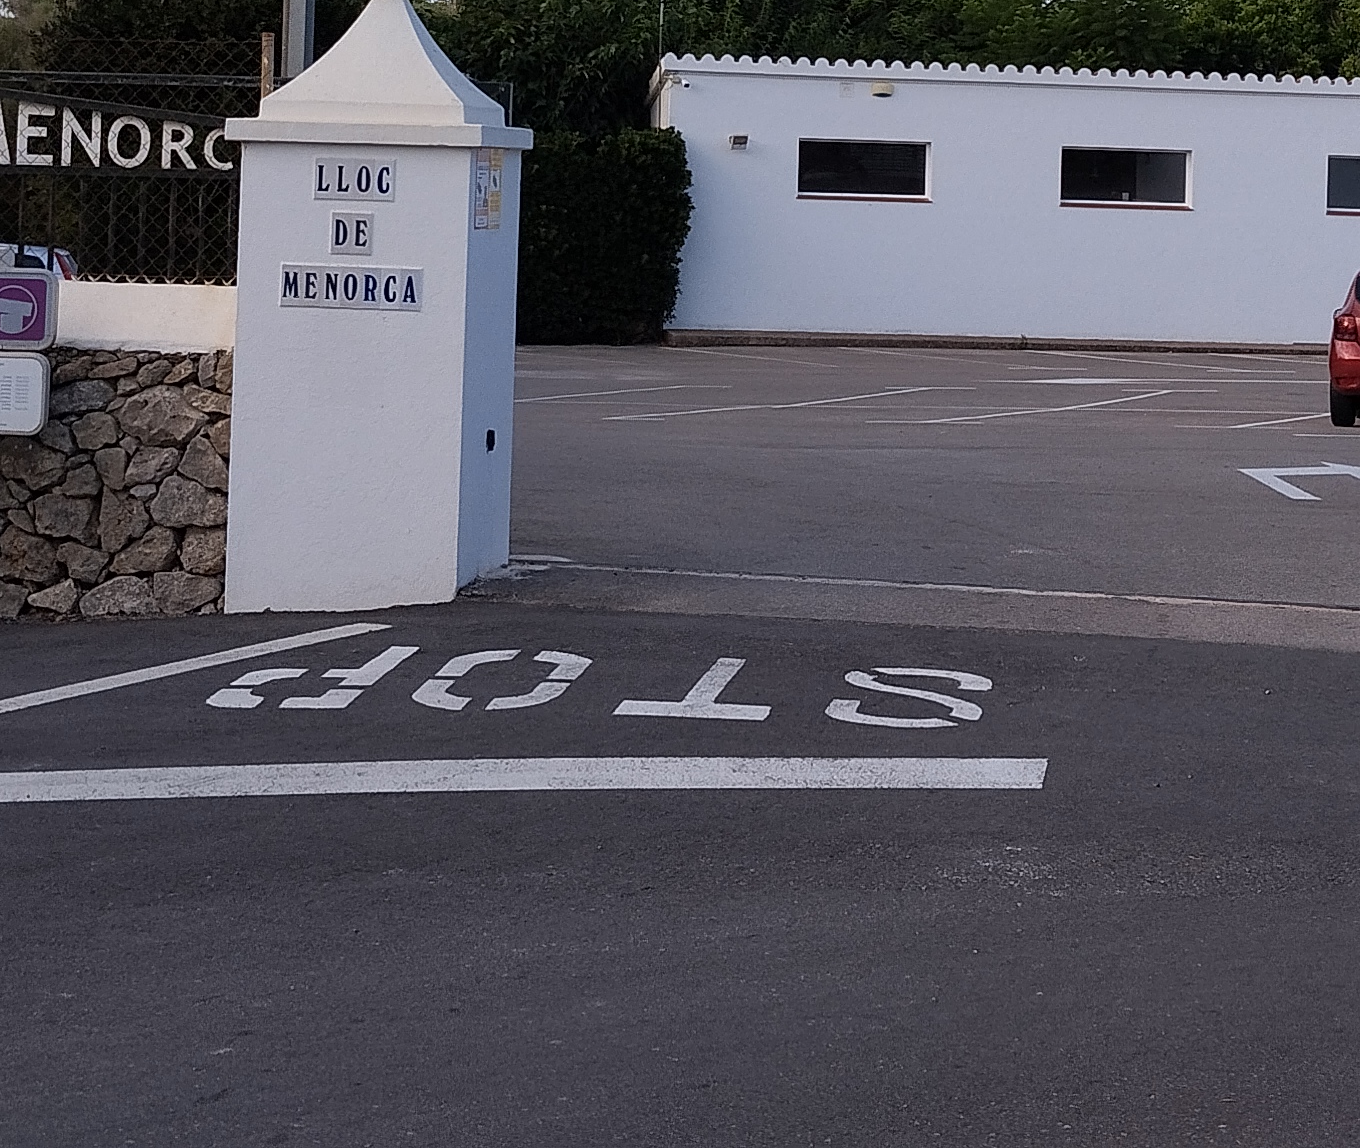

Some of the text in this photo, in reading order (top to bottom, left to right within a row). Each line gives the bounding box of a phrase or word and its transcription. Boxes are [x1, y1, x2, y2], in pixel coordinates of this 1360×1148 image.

[316, 164, 391, 194] LLOC
[334, 218, 369, 248] DE
[282, 270, 417, 304] MENORCA
[206, 645, 994, 729] STOP
